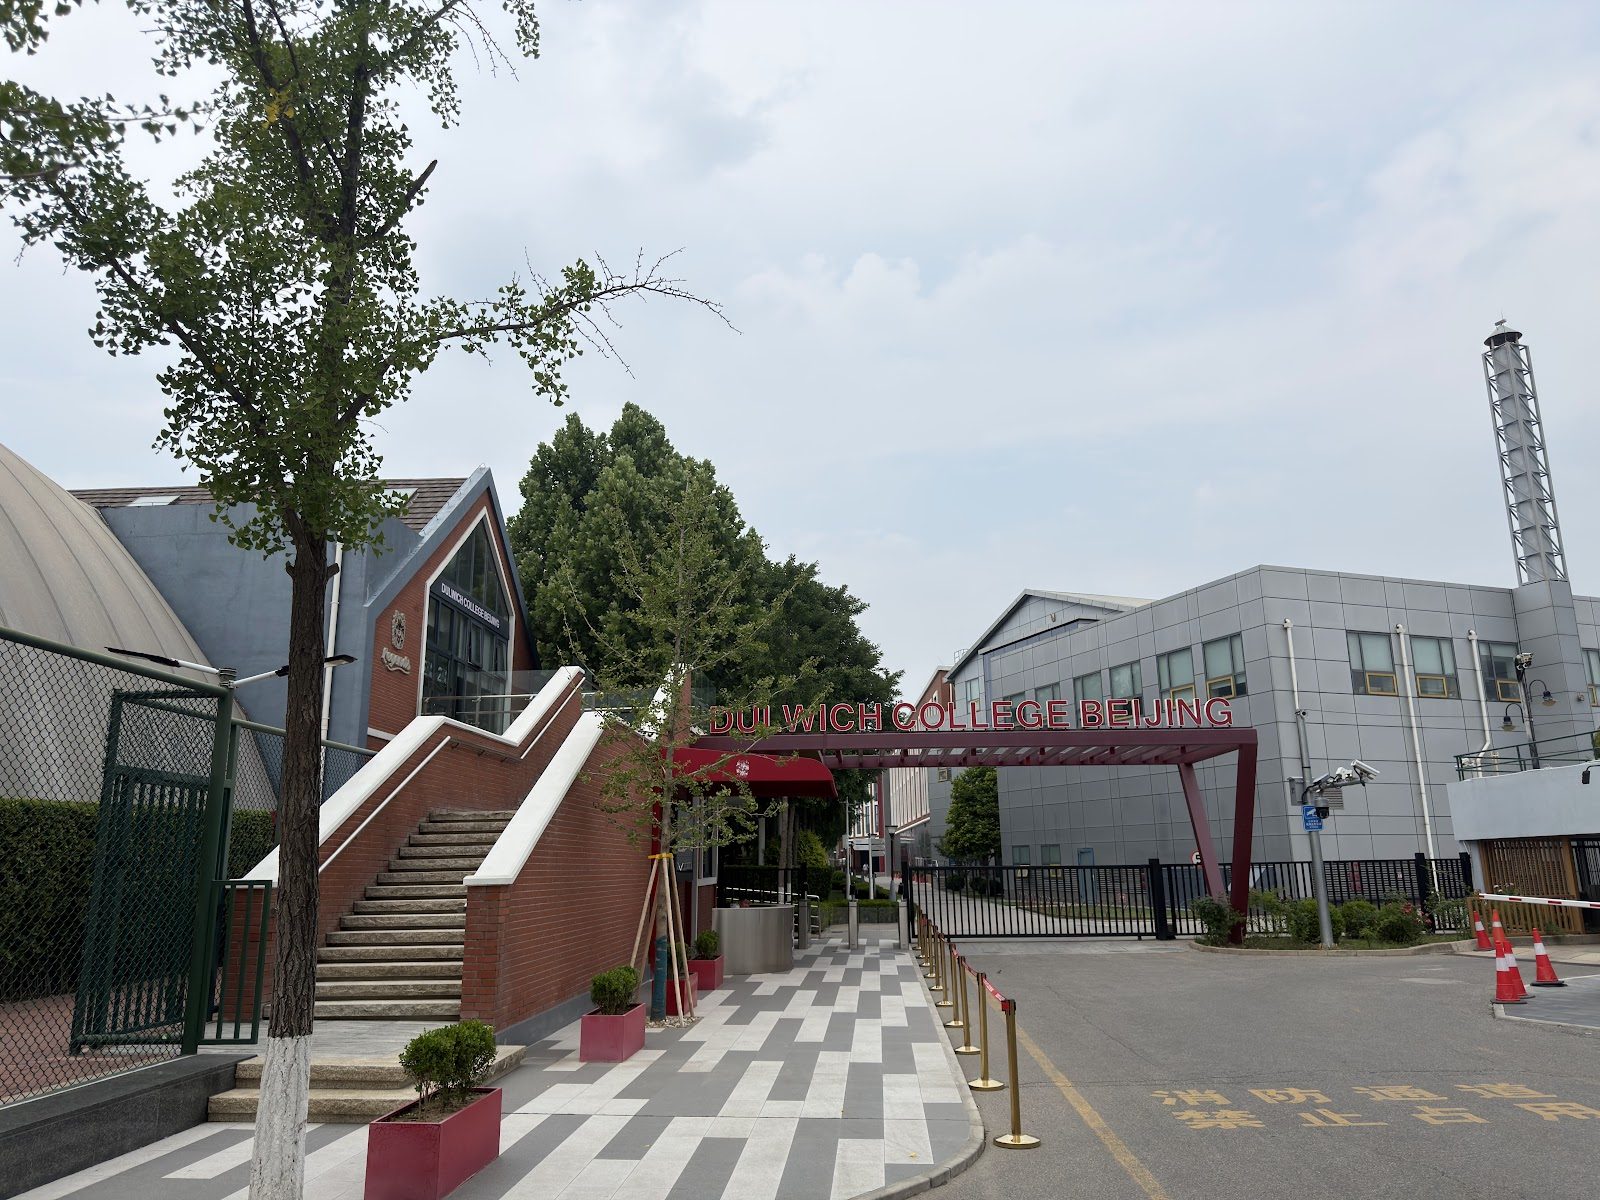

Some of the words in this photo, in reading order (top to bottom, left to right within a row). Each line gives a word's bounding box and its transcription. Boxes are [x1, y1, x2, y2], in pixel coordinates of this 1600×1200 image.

[441, 583, 464, 605] DULWICH
[464, 597, 484, 618] COLLEGE
[709, 702, 883, 733] DULWICH
[892, 699, 1071, 730] COLLEGE
[1079, 698, 1233, 729] BEIJING
[1150, 1083, 1557, 1105] 消防通道
[1171, 1102, 1600, 1129] 禁止占用
